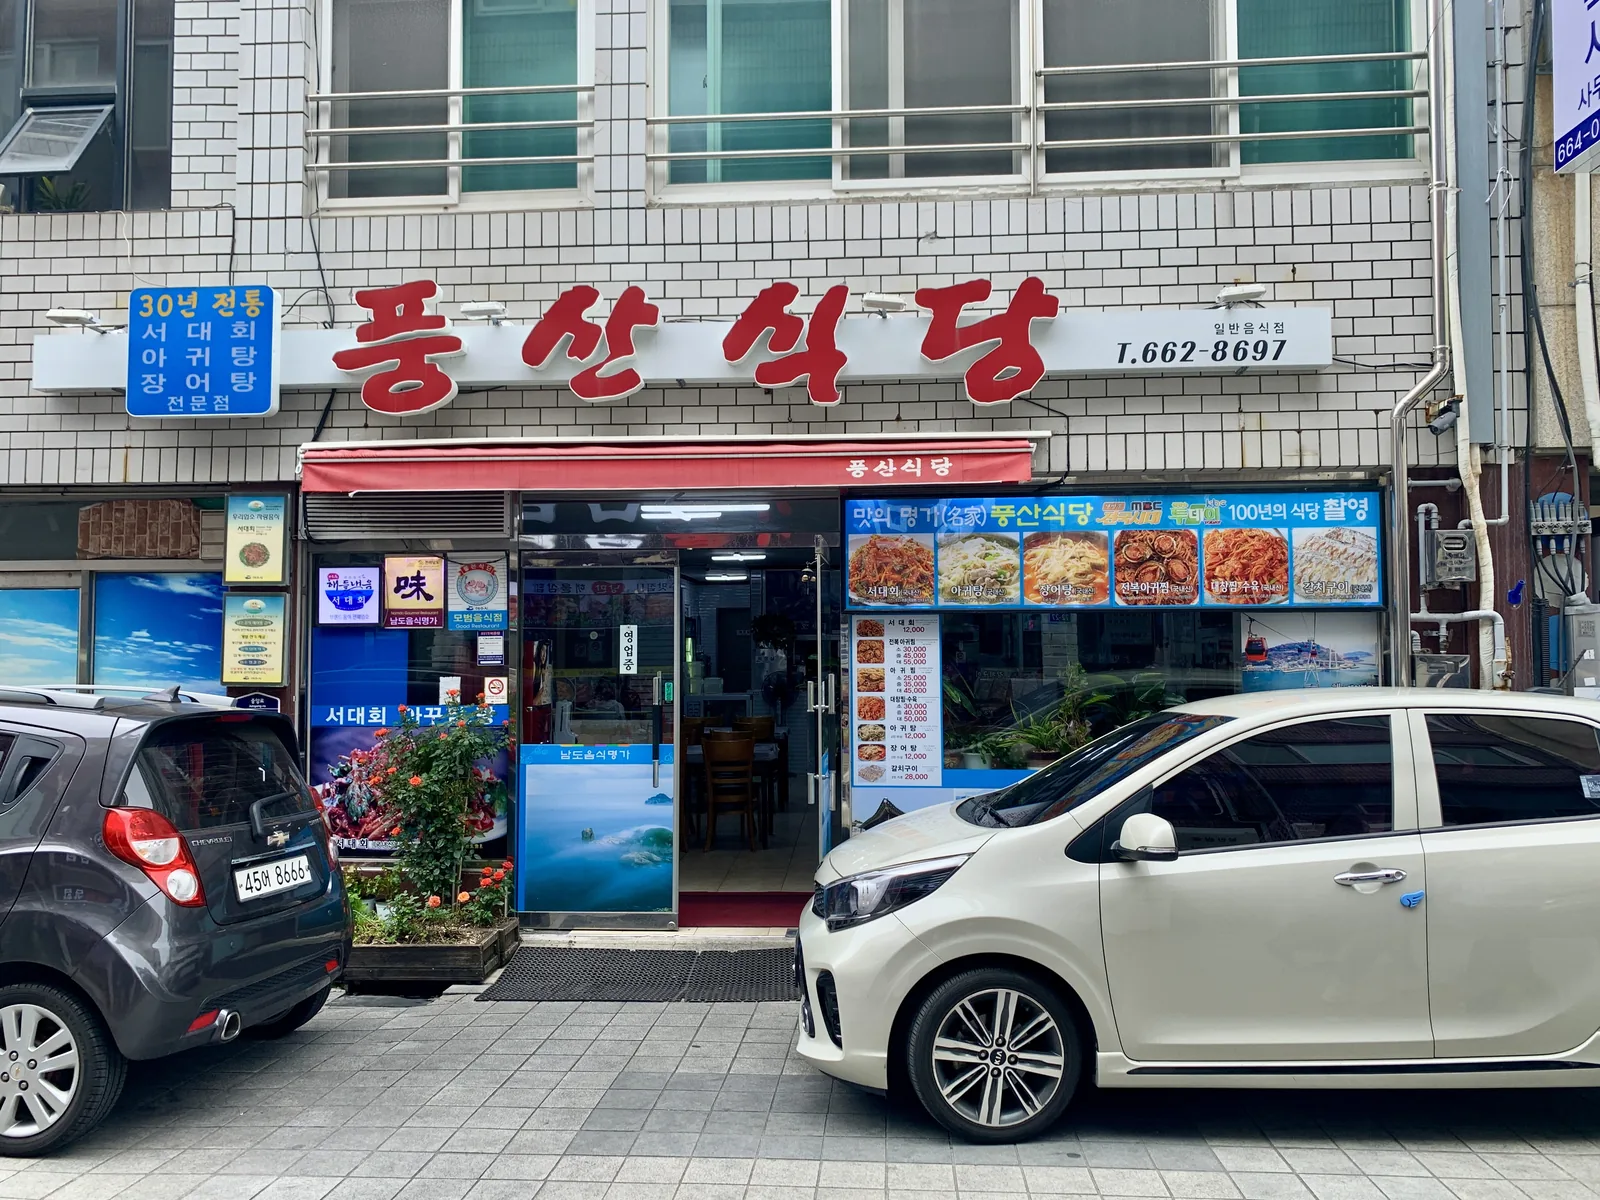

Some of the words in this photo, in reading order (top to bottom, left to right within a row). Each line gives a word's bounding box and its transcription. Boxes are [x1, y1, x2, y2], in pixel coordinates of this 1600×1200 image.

[139, 290, 198, 318] 30년
[212, 289, 264, 318] 전통
[1214, 321, 1285, 335] 일반음식점
[332, 276, 1060, 415] 풍산식당
[1117, 339, 1287, 364] T.662-8697
[167, 395, 229, 412] 전문점
[846, 457, 953, 478] 풍산식당
[1131, 501, 1162, 511] MBC
[1168, 501, 1220, 525] 투데이
[1228, 503, 1287, 521] 100년의
[1290, 502, 1320, 521] 식당
[1323, 497, 1369, 521] 촬영
[853, 505, 891, 528] 맛의
[991, 502, 1094, 527] 풍산식당
[393, 569, 434, 602] 味
[867, 585, 899, 597] 서대회
[950, 584, 984, 597] 아귀탕
[1039, 584, 1073, 597] 장어탕
[1120, 581, 1169, 594] 전복아귀찜
[1302, 580, 1349, 594] 갈치구이
[390, 616, 438, 626] 남도음식명가
[453, 612, 503, 623] 모범음식점
[623, 630, 634, 671] 영업중
[325, 706, 386, 725] 서대회
[560, 749, 631, 760] 남도음식명가
[191, 836, 233, 847] CHEVROLET
[275, 859, 305, 886] 8666
[994, 1050, 1003, 1065] KIA
